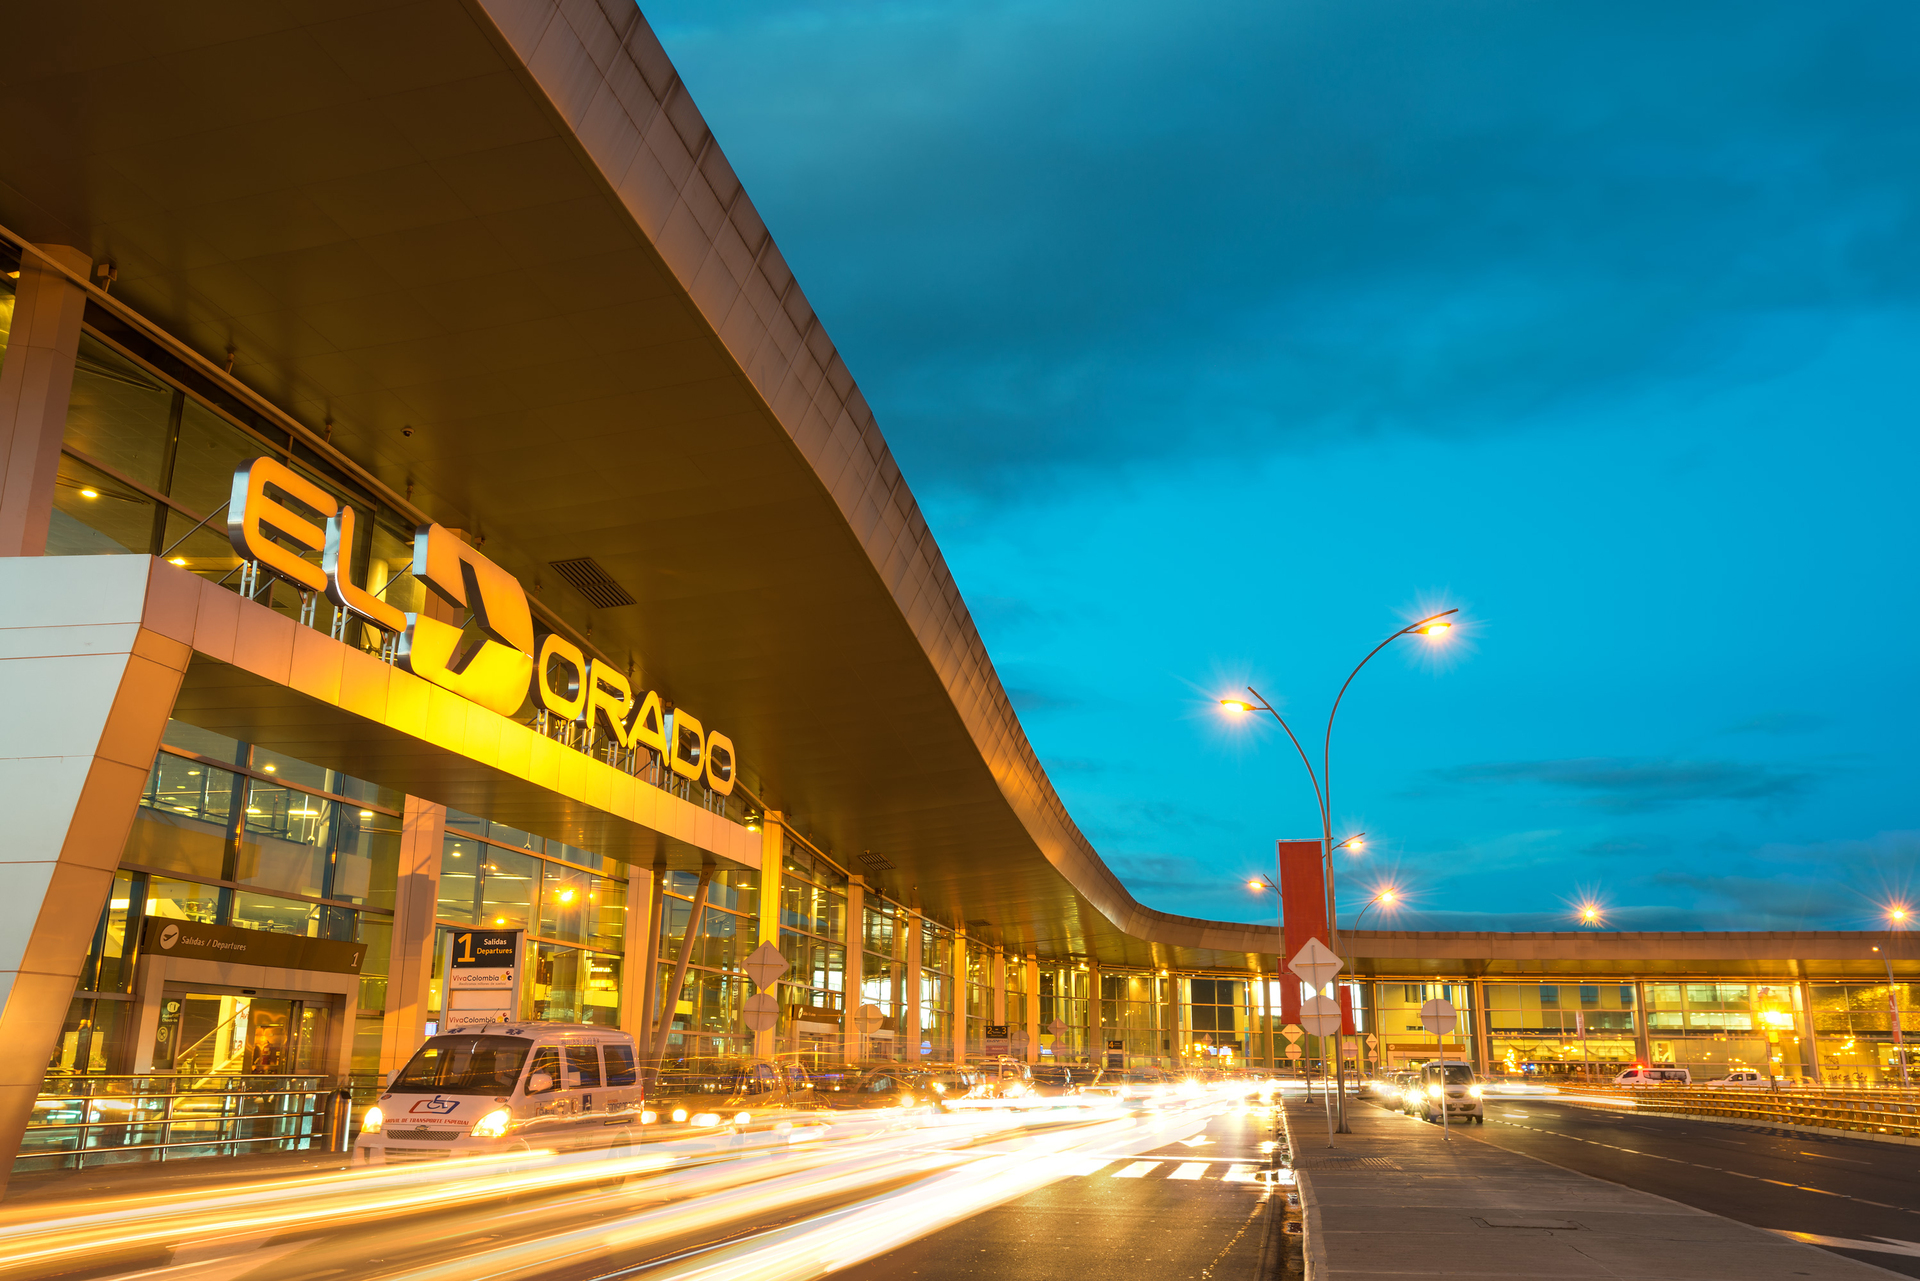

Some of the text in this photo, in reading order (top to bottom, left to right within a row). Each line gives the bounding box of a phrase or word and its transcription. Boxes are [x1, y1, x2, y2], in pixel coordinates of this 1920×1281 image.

[228, 456, 407, 633] EL
[181, 935, 205, 947] Salidas
[211, 938, 247, 951] Departures
[457, 933, 475, 962] 1
[483, 938, 507, 946] Salidas
[476, 947, 513, 955] Departures
[350, 952, 359, 967] 1
[452, 974, 500, 982] VivaColombia
[449, 1016, 496, 1024] VivaColombia
